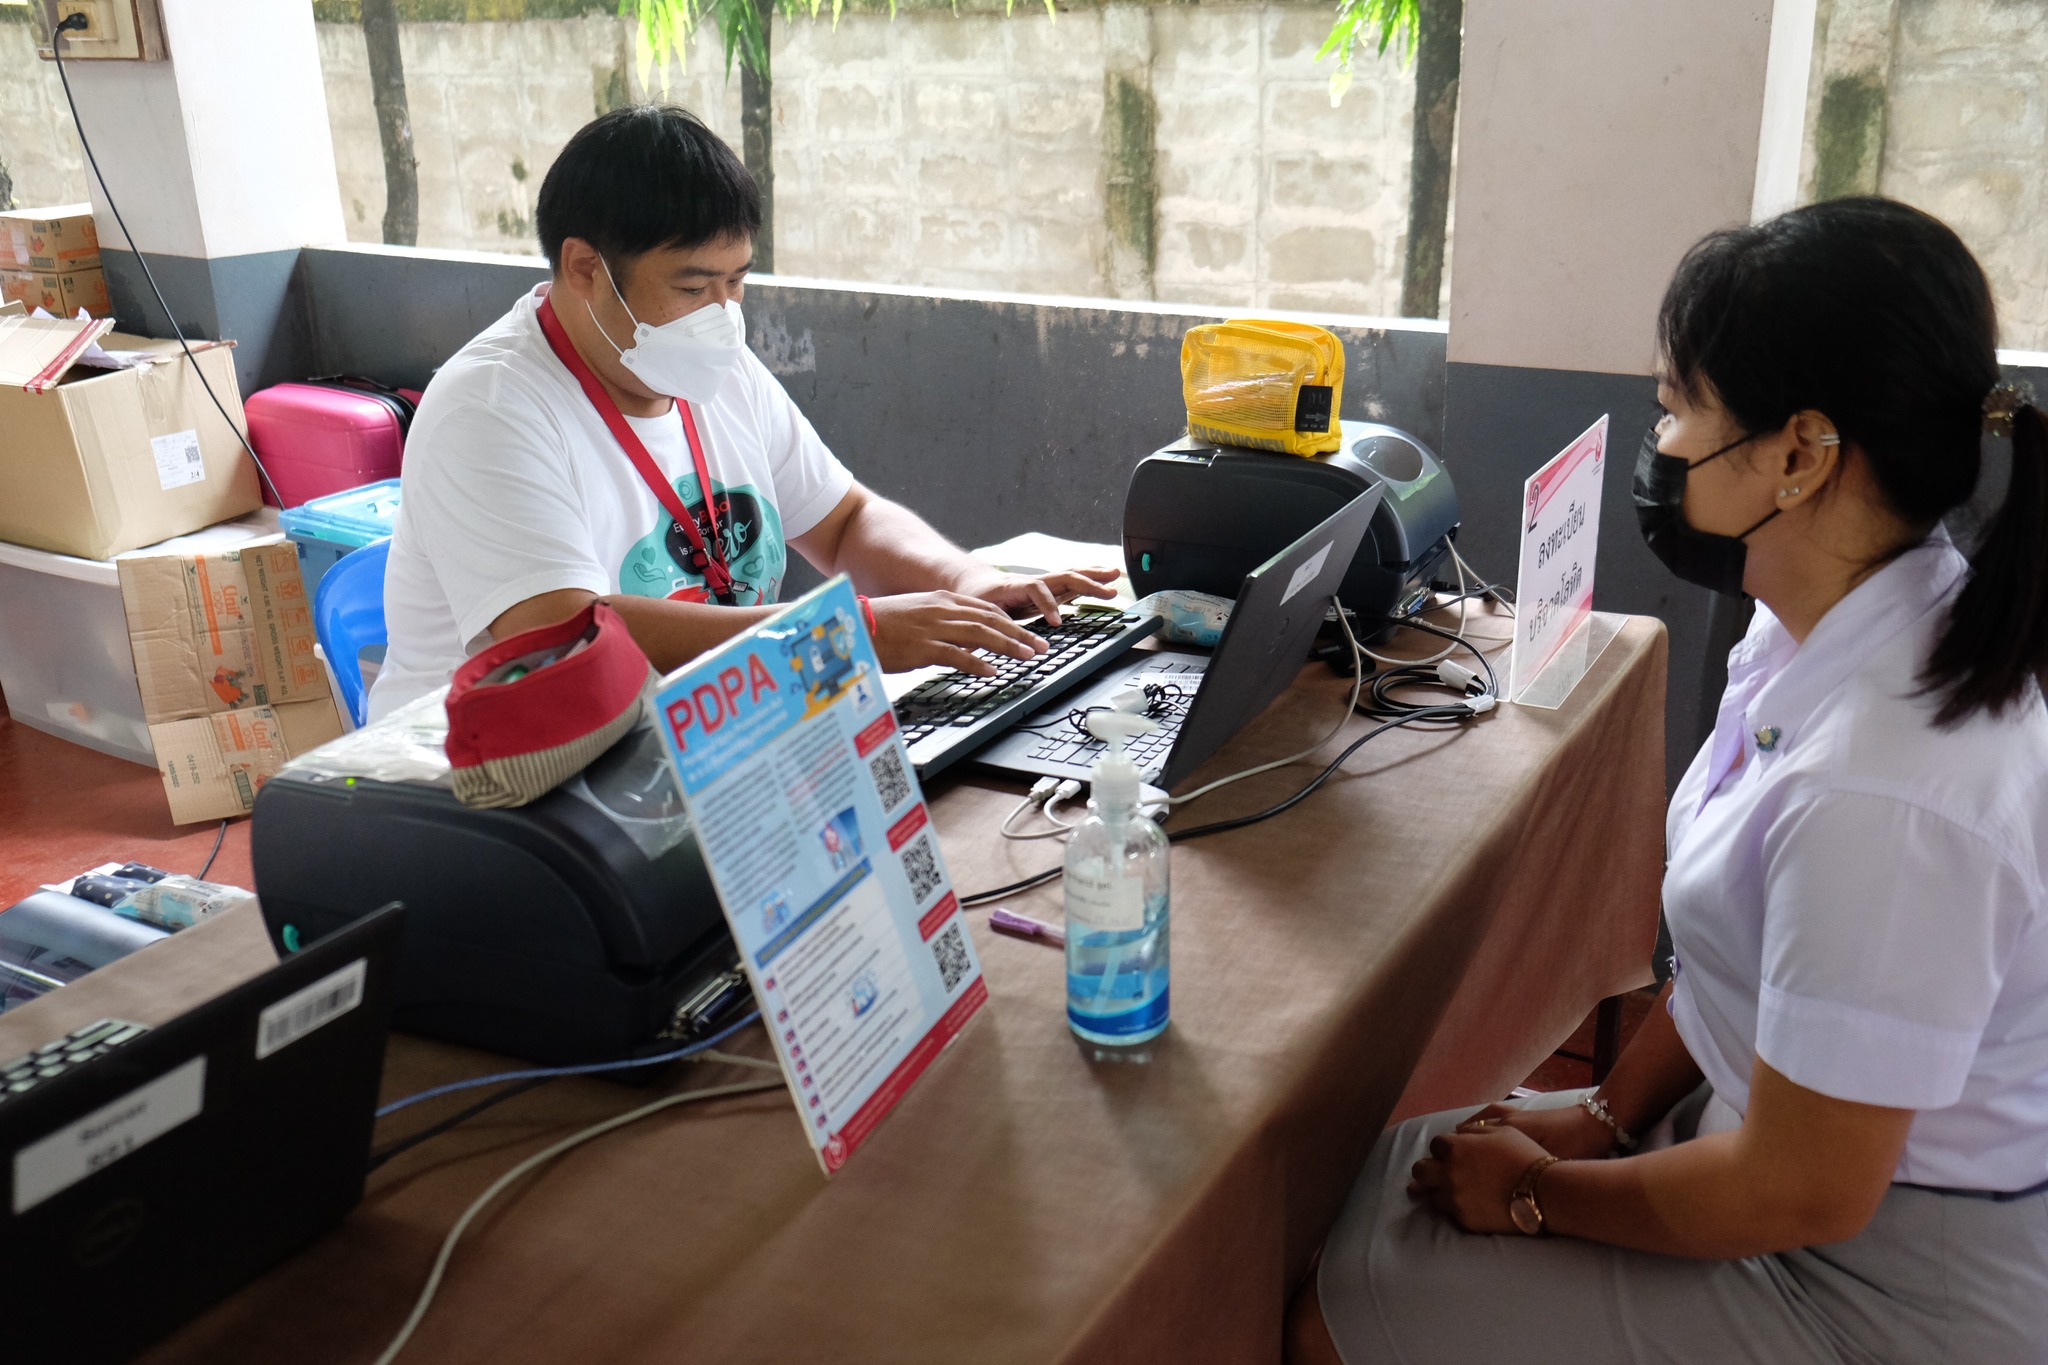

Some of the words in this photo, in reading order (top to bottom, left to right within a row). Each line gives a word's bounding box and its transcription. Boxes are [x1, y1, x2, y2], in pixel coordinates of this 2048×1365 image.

[1528, 484, 1541, 534] 2
[1538, 500, 1586, 569] ลงทะเบียน
[258, 566, 268, 592] WEIGHT
[223, 585, 241, 617] Unif
[1529, 562, 1583, 642] บริจาคโลหิต
[268, 623, 279, 645] GROSS
[273, 645, 284, 671] WEIGHT
[665, 652, 778, 752] PDPA
[252, 721, 272, 750] Unif
